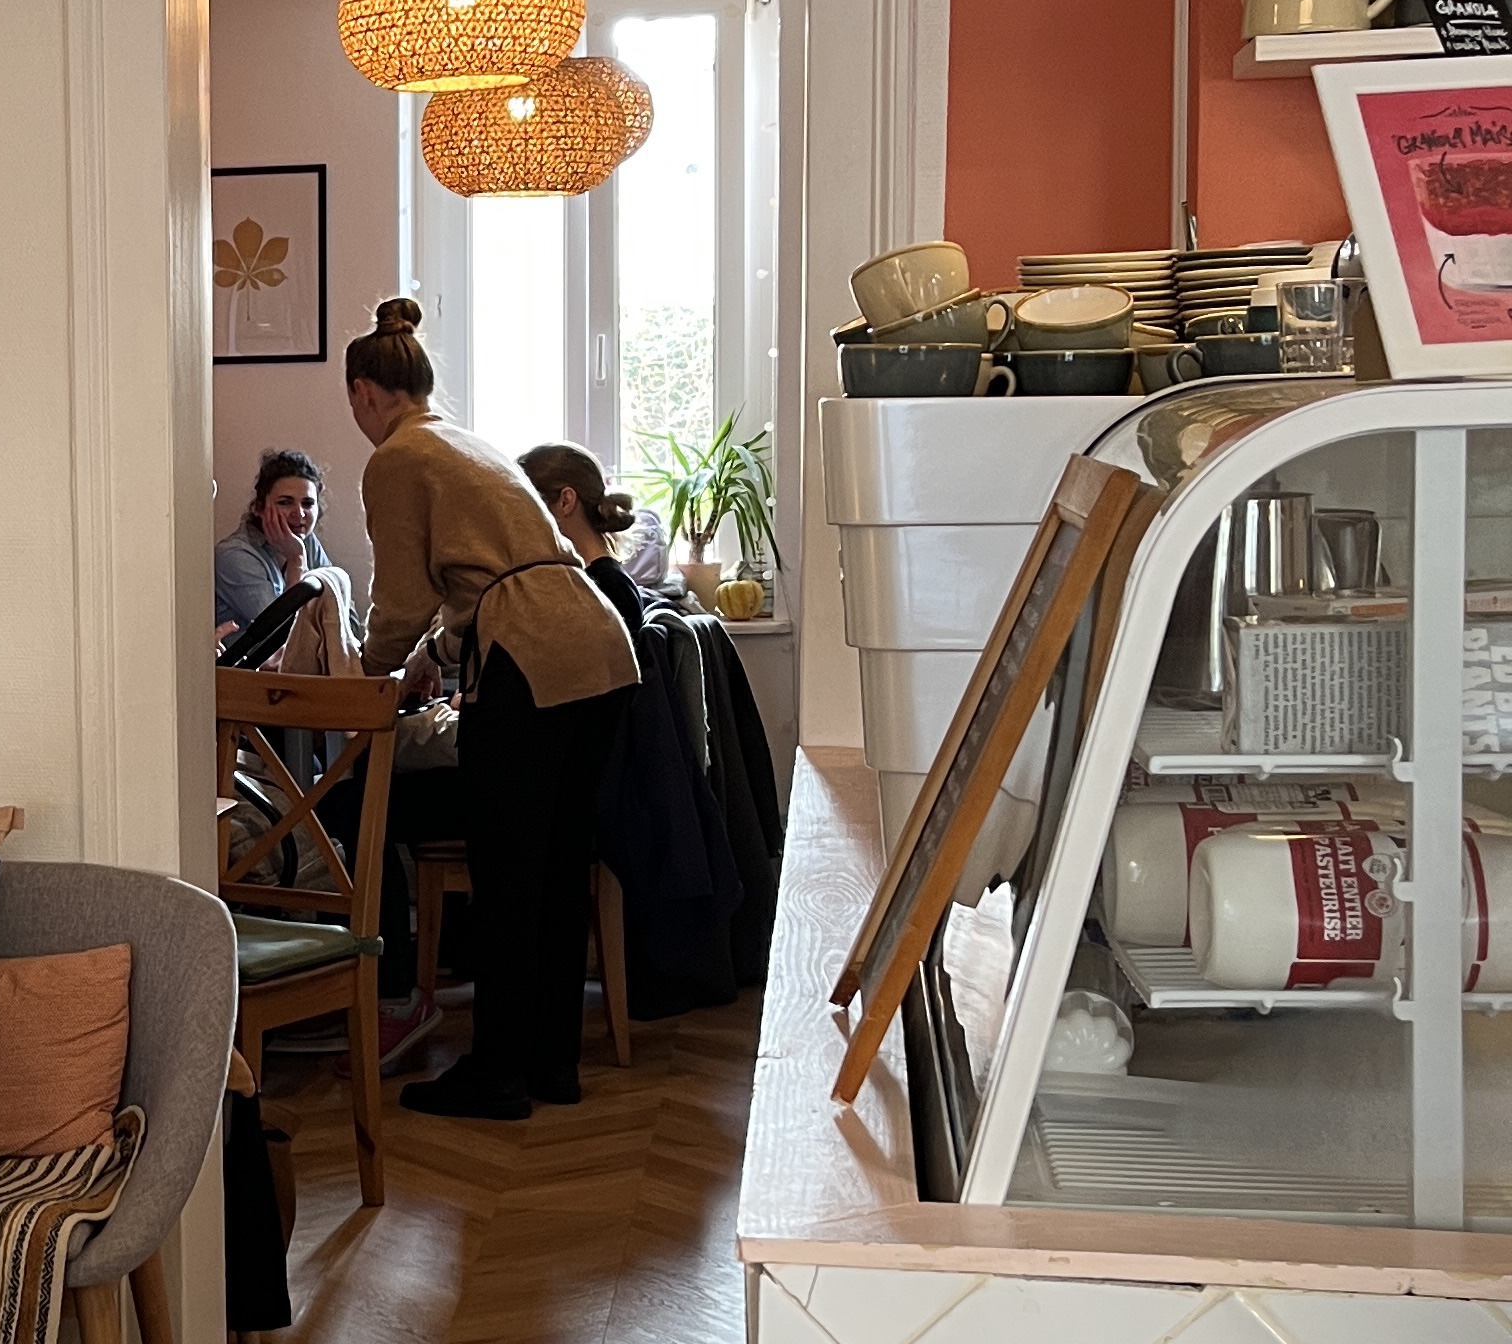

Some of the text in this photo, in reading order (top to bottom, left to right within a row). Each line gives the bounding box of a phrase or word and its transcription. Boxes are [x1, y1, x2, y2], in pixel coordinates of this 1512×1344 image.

[1335, 837, 1356, 873] LAIT
[1313, 836, 1345, 941] PASTEURISÉ
[1341, 877, 1363, 940] ENTIER
